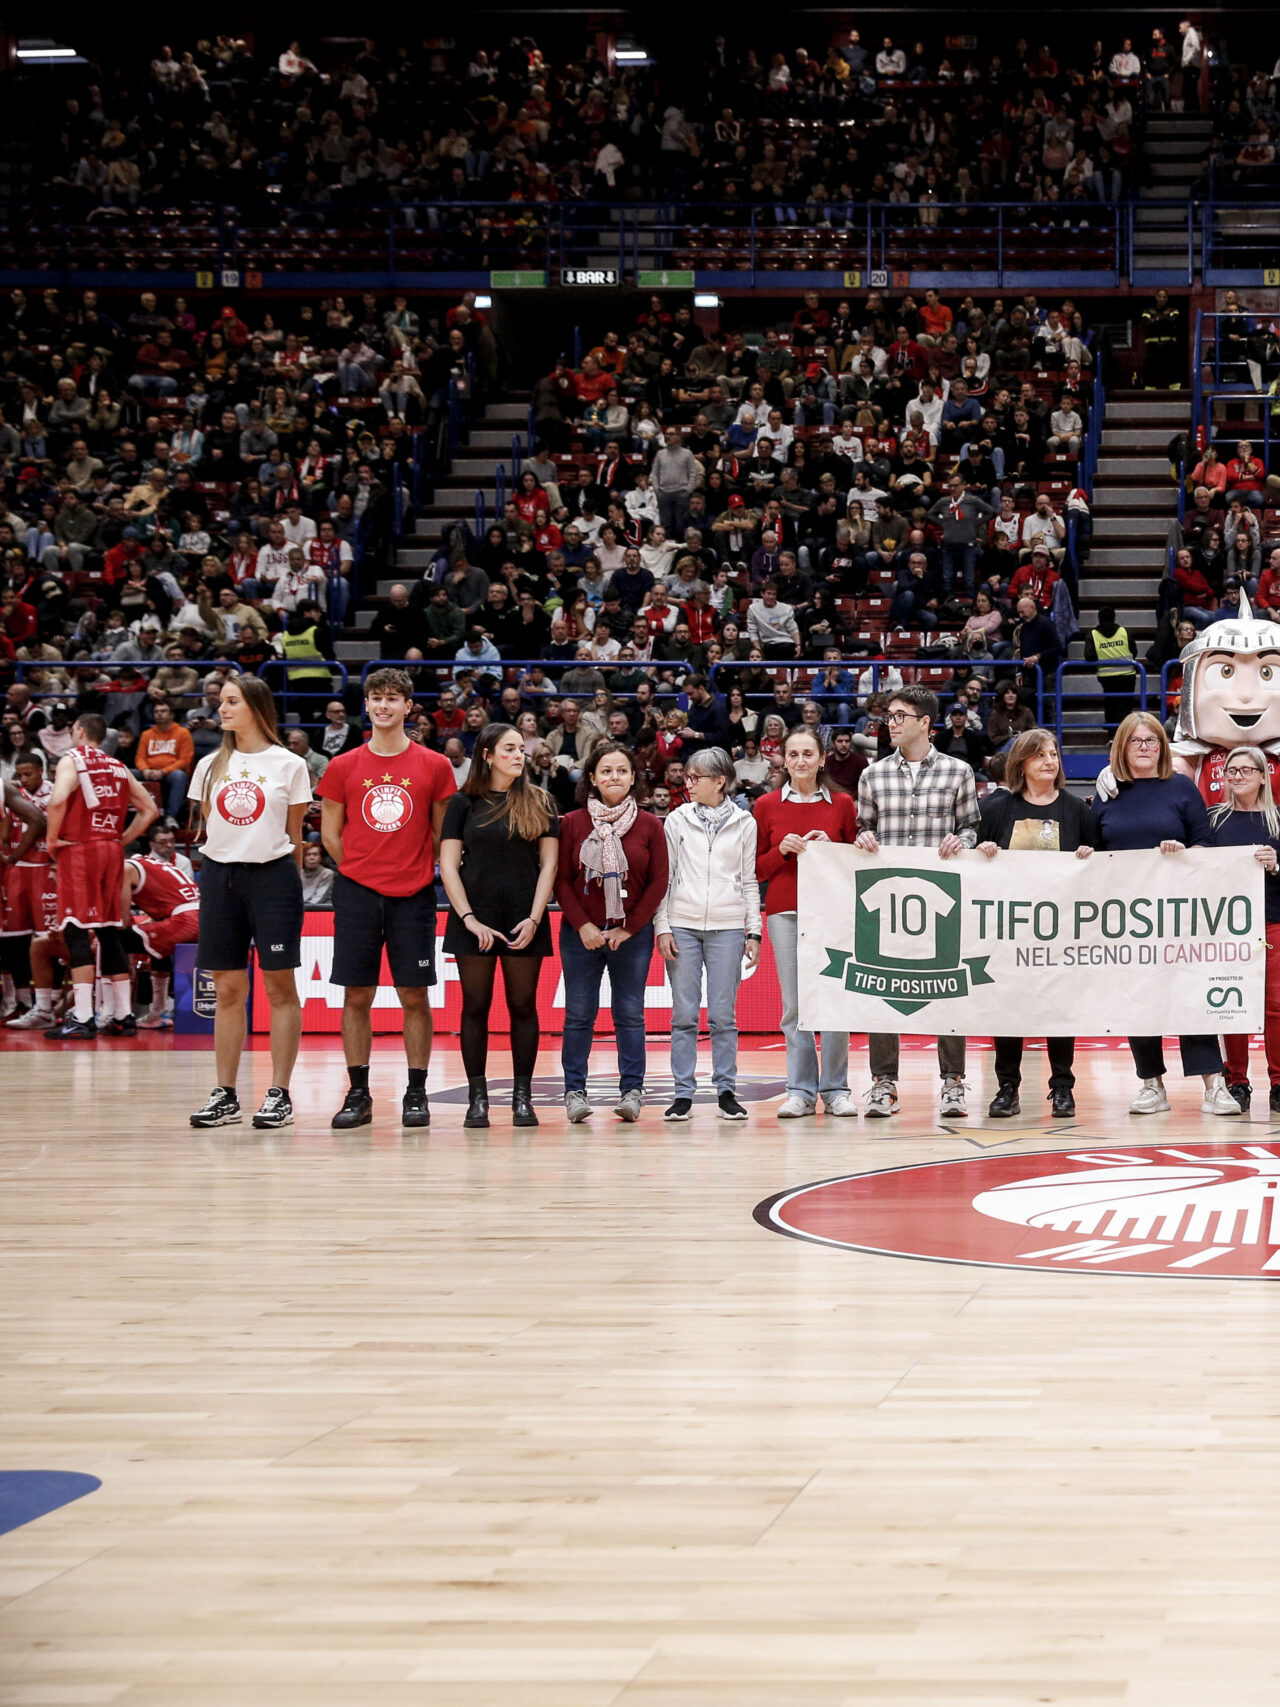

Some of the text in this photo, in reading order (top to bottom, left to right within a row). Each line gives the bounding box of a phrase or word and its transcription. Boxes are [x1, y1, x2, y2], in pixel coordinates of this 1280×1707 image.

[576, 271, 606, 284] BAR
[872, 273, 886, 284] 20
[227, 782, 257, 790] OLIMPIA
[371, 787, 402, 796] OLIMPIA
[228, 816, 254, 825] MILANO
[374, 820, 401, 830] MILANO
[890, 893, 927, 936] 10
[971, 895, 1252, 941] TIFO POSITIVO
[1016, 941, 1252, 967] NEL SEGNO DI CANDIDO
[199, 981, 216, 991] LB
[854, 972, 958, 994] TIFO POSITIVO
